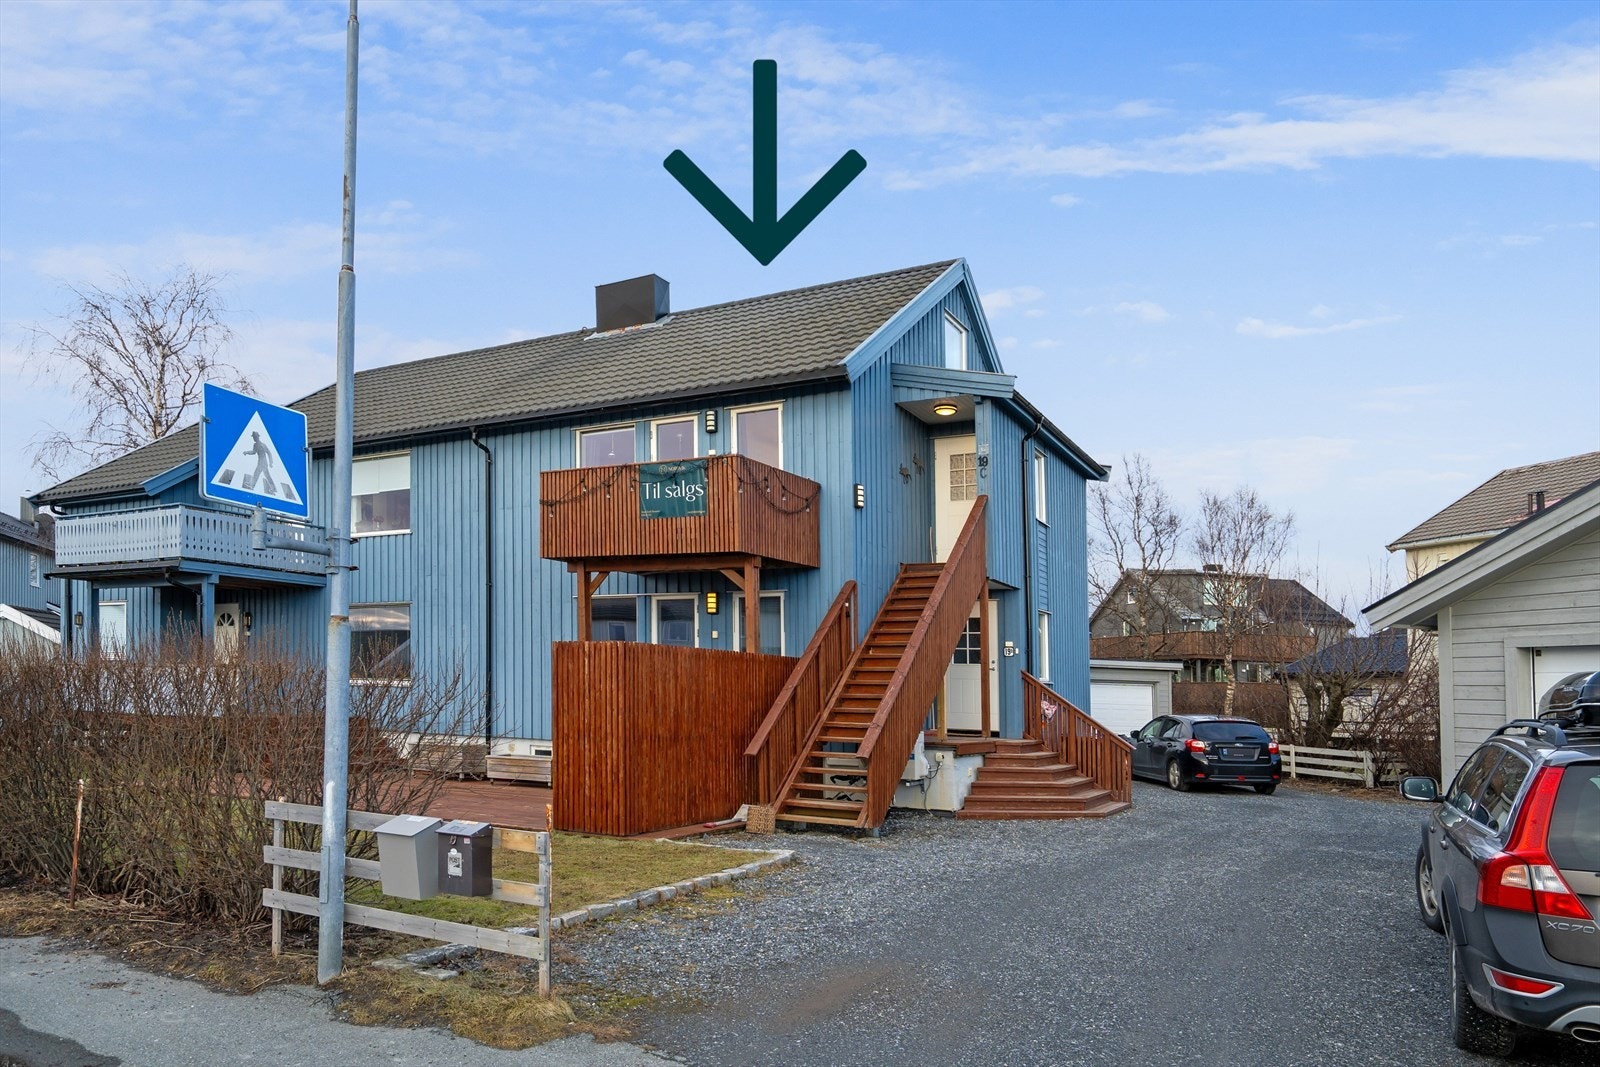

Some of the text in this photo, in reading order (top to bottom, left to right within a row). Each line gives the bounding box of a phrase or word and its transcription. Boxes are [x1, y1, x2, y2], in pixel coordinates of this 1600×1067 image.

[977, 456, 988, 467] 19
[642, 480, 704, 502] Til salgs
[1546, 920, 1595, 934] XC70
